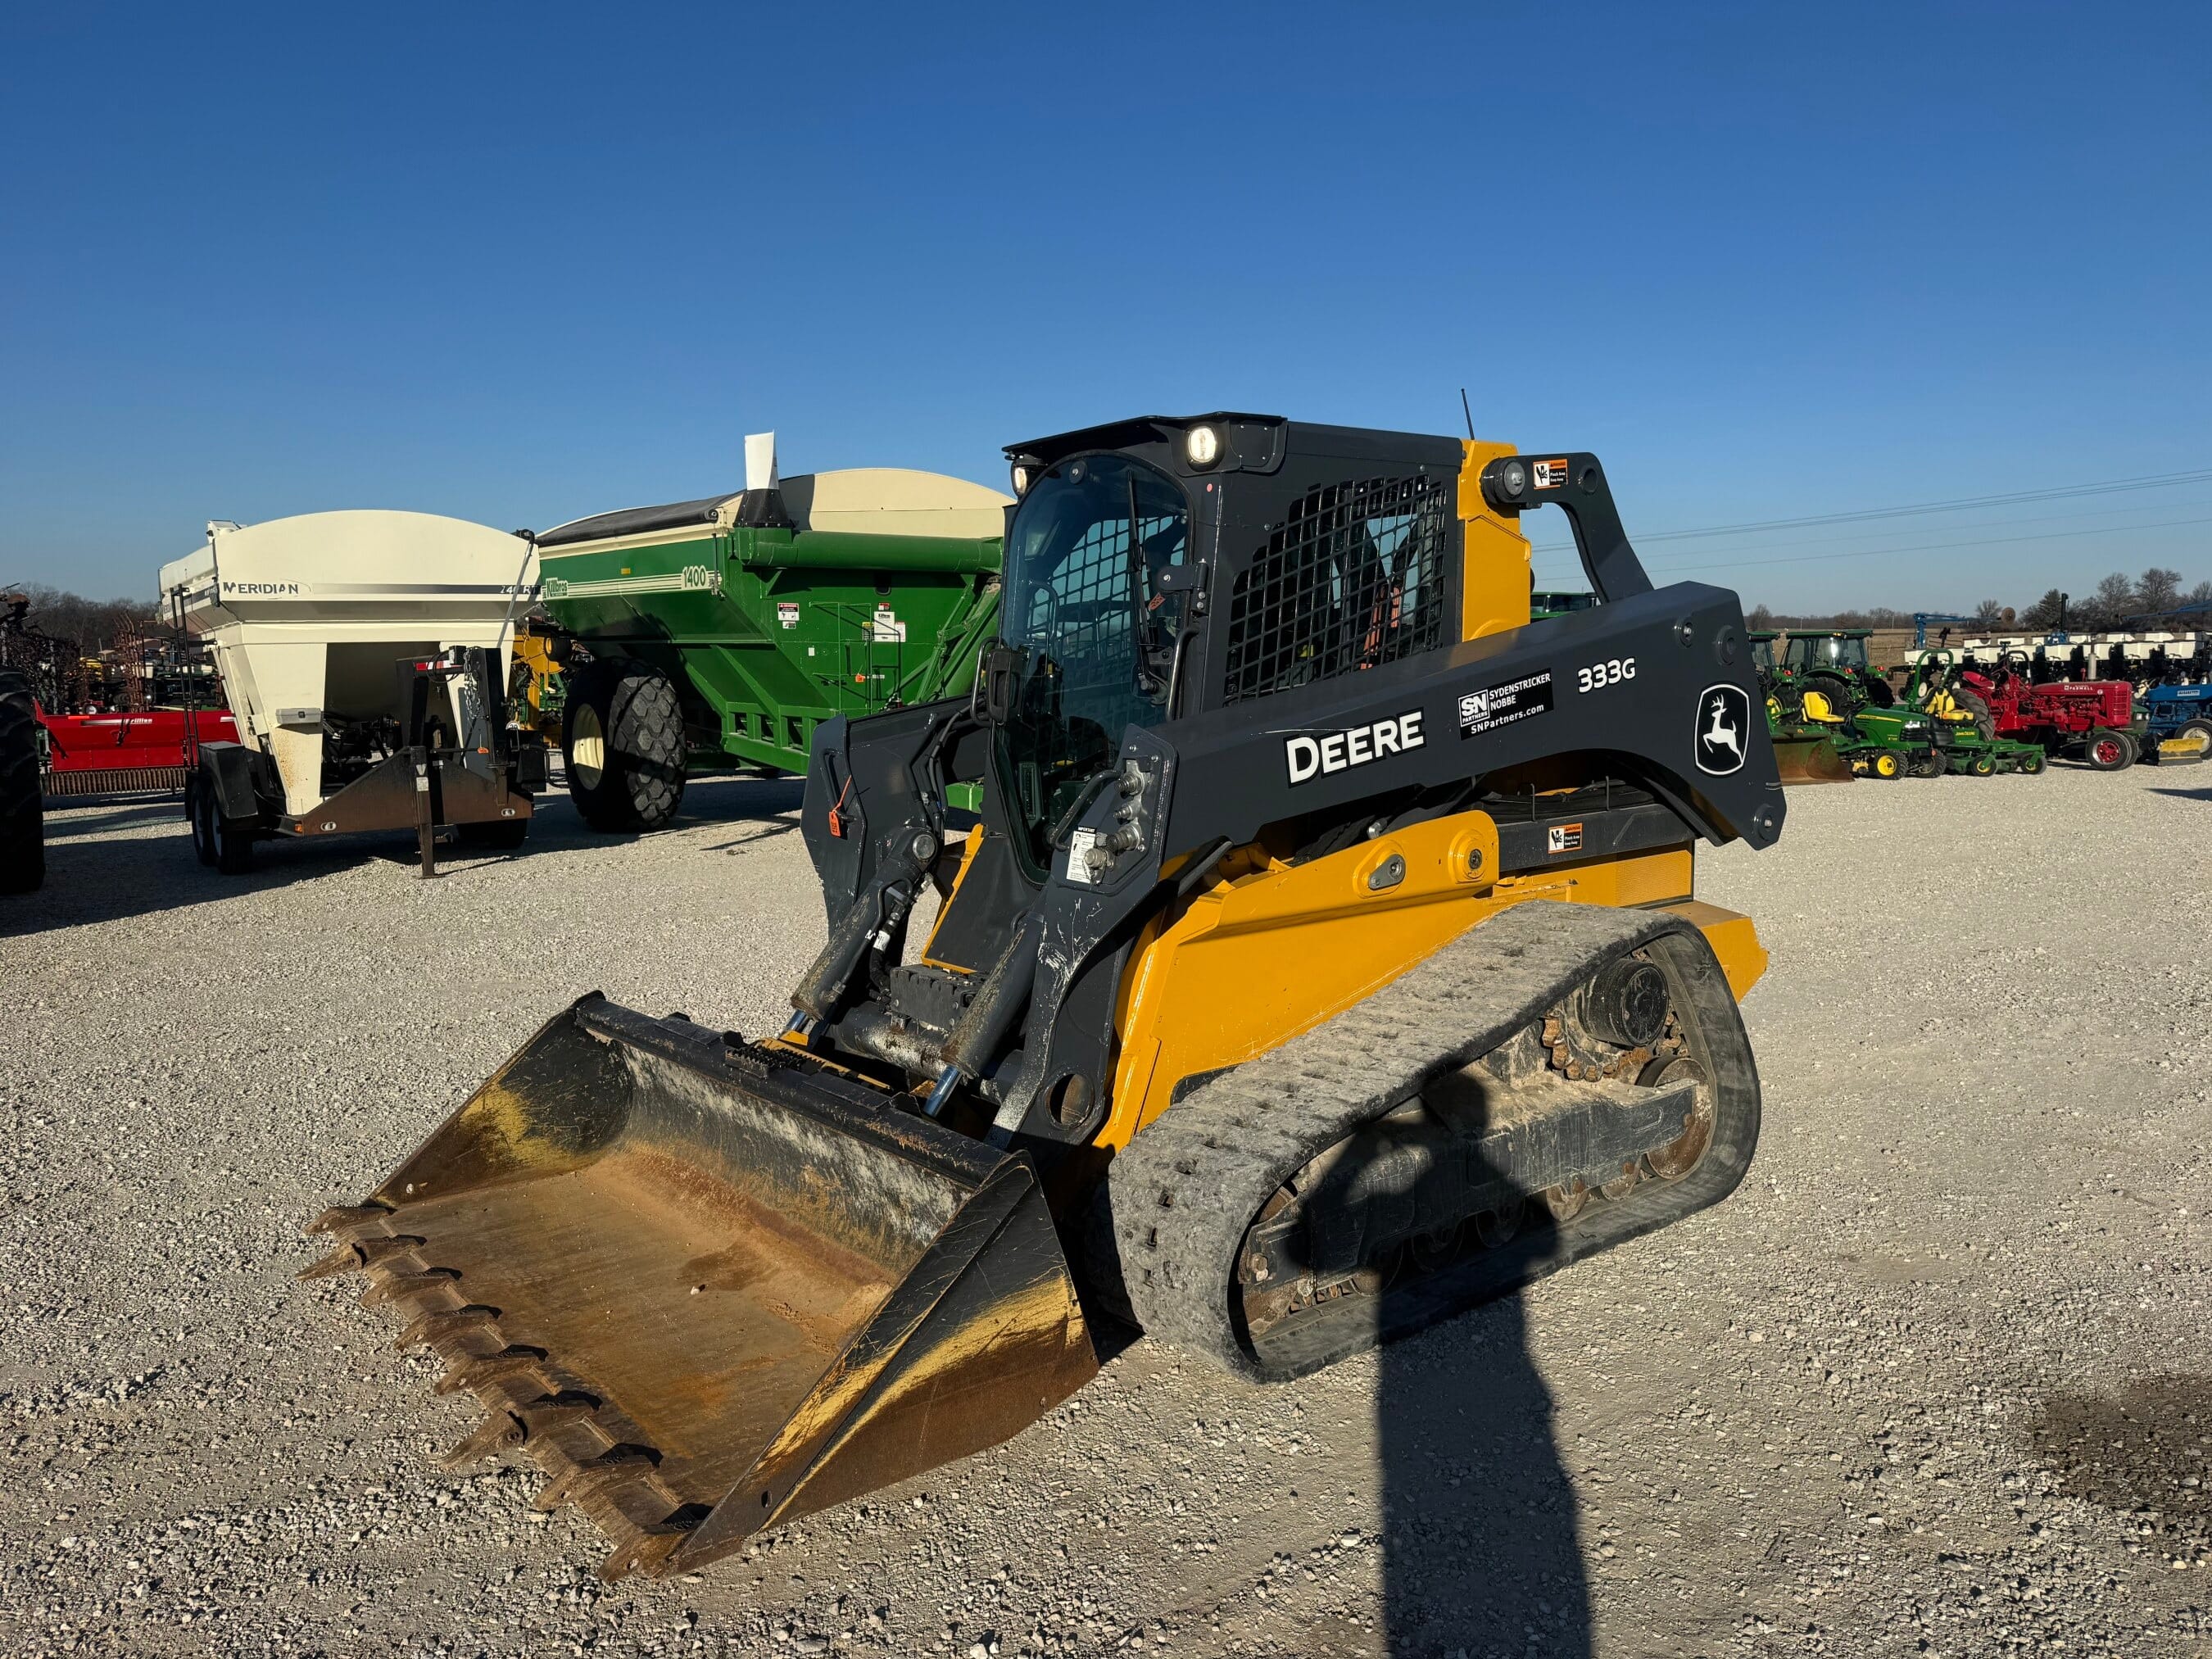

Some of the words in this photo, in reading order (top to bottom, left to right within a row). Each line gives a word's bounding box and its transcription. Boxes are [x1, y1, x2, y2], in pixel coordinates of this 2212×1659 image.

[223, 582, 298, 594] MERIDIAN
[546, 579, 568, 597] Killbros
[683, 568, 706, 588] 1400
[1578, 657, 1636, 693] 333G
[1489, 673, 1551, 700] SYDENSTRICKER
[1461, 693, 1488, 717] SN
[1490, 695, 1516, 711] NOBBE
[1462, 710, 1488, 723] PARTNERS
[1471, 705, 1544, 734] SNPartners.com
[1286, 711, 1424, 784] DEERE
